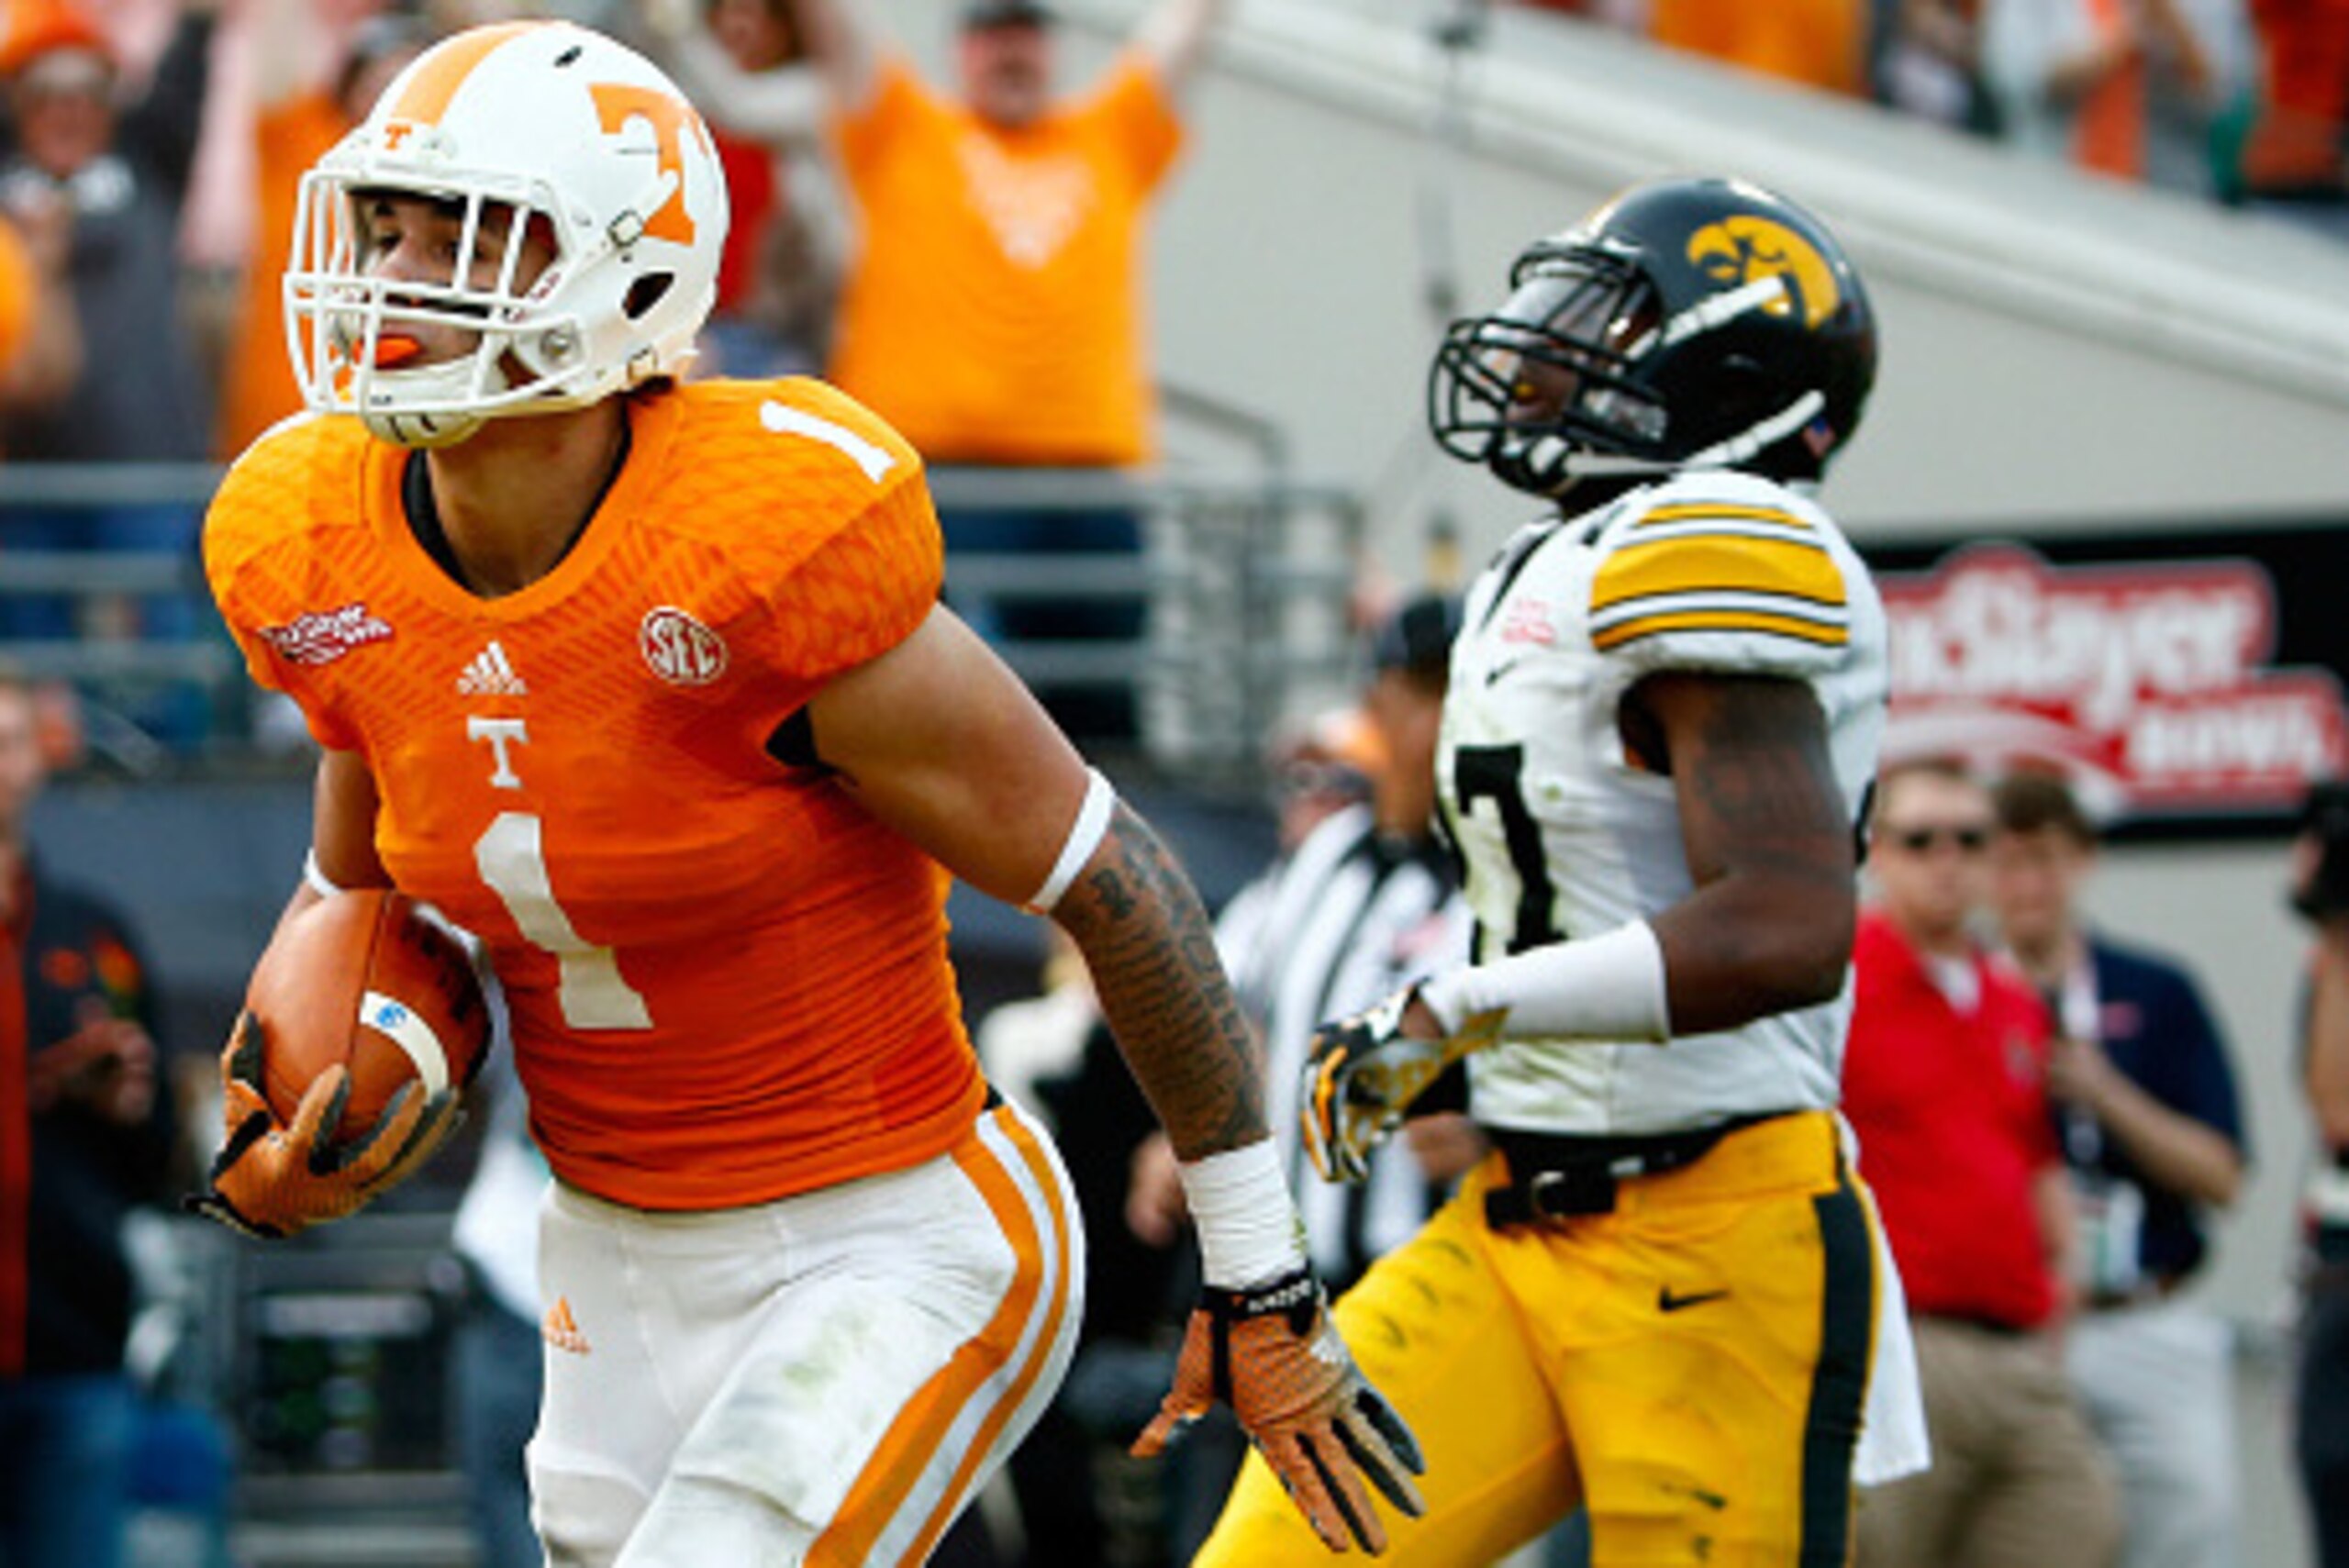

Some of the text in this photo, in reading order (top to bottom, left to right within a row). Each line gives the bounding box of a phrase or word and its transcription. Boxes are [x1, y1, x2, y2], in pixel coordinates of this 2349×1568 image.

[384, 123, 412, 150] T
[587, 83, 709, 248] T
[760, 399, 896, 484] 1
[648, 613, 718, 678] SEC
[467, 715, 529, 790] T
[473, 811, 654, 1029] 1
